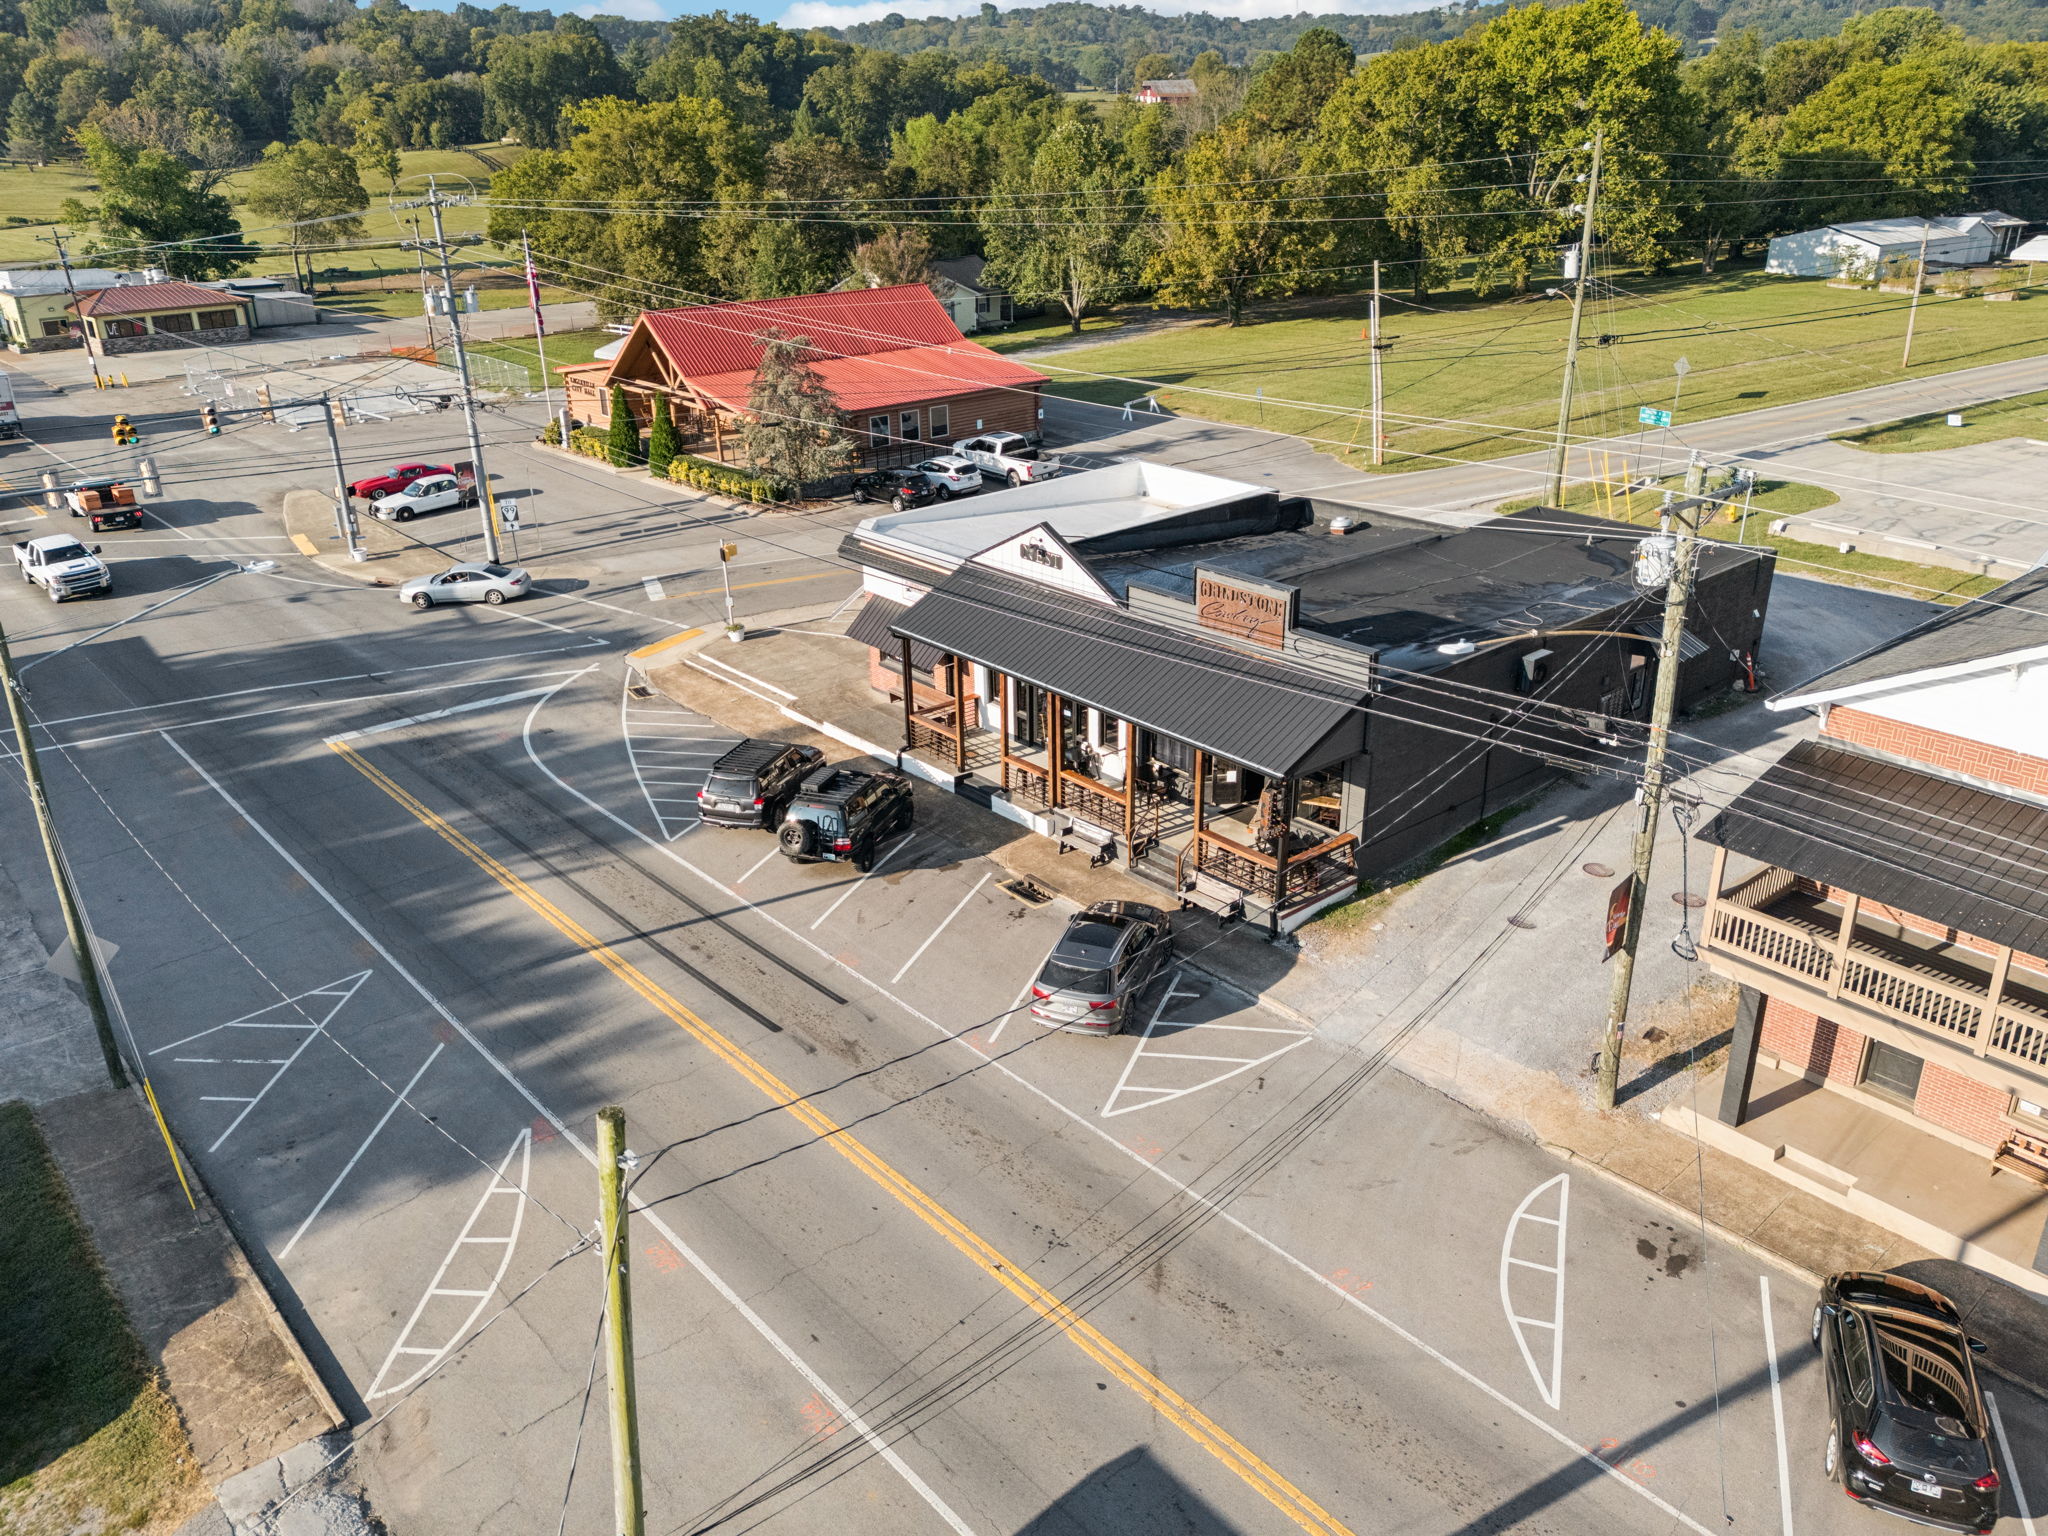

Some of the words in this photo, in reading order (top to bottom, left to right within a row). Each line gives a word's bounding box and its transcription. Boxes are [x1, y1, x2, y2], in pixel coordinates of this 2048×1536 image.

[572, 385, 582, 393] CITY
[584, 388, 596, 397] HALL
[503, 506, 516, 514] 99
[1022, 544, 1061, 569] NEST
[1200, 580, 1283, 618] GRINDSTONE
[1200, 601, 1278, 639] Cowboy
